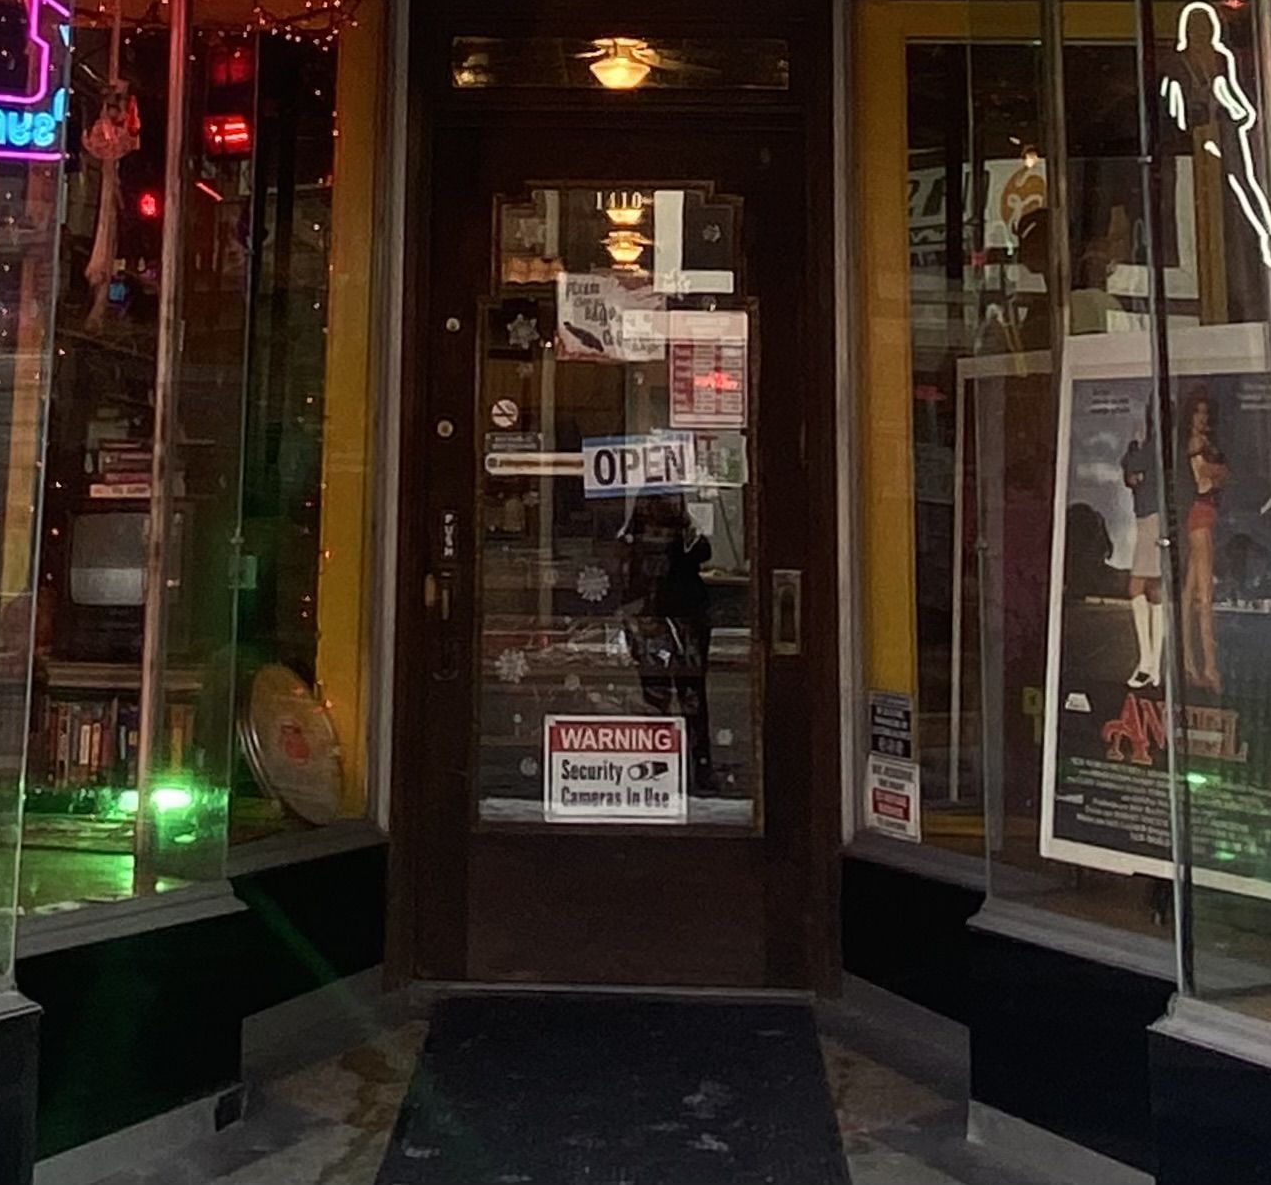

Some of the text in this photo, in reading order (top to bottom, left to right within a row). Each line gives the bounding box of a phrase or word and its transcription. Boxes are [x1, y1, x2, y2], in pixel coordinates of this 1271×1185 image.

[593, 444, 686, 486] OPEN
[559, 728, 672, 751] WARNING
[561, 759, 623, 785] Security
[561, 786, 622, 807] Cameras
[644, 786, 669, 808] Use
